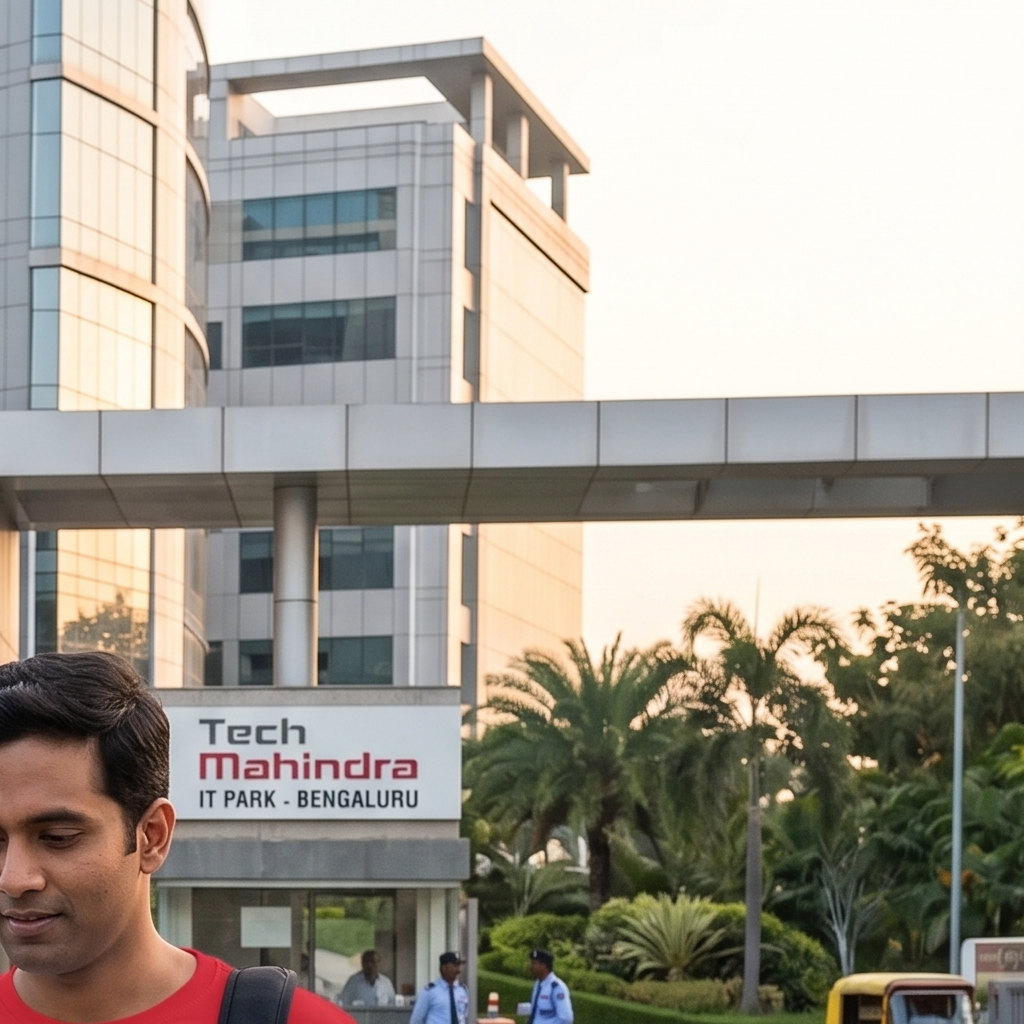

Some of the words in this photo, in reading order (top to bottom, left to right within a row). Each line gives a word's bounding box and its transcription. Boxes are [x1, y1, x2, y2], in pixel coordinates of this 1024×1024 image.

[199, 718, 306, 745] Tech
[199, 752, 418, 780] Mahindra
[199, 789, 217, 809] IT
[224, 789, 276, 809] PARK
[297, 789, 419, 809] BENGALURU
